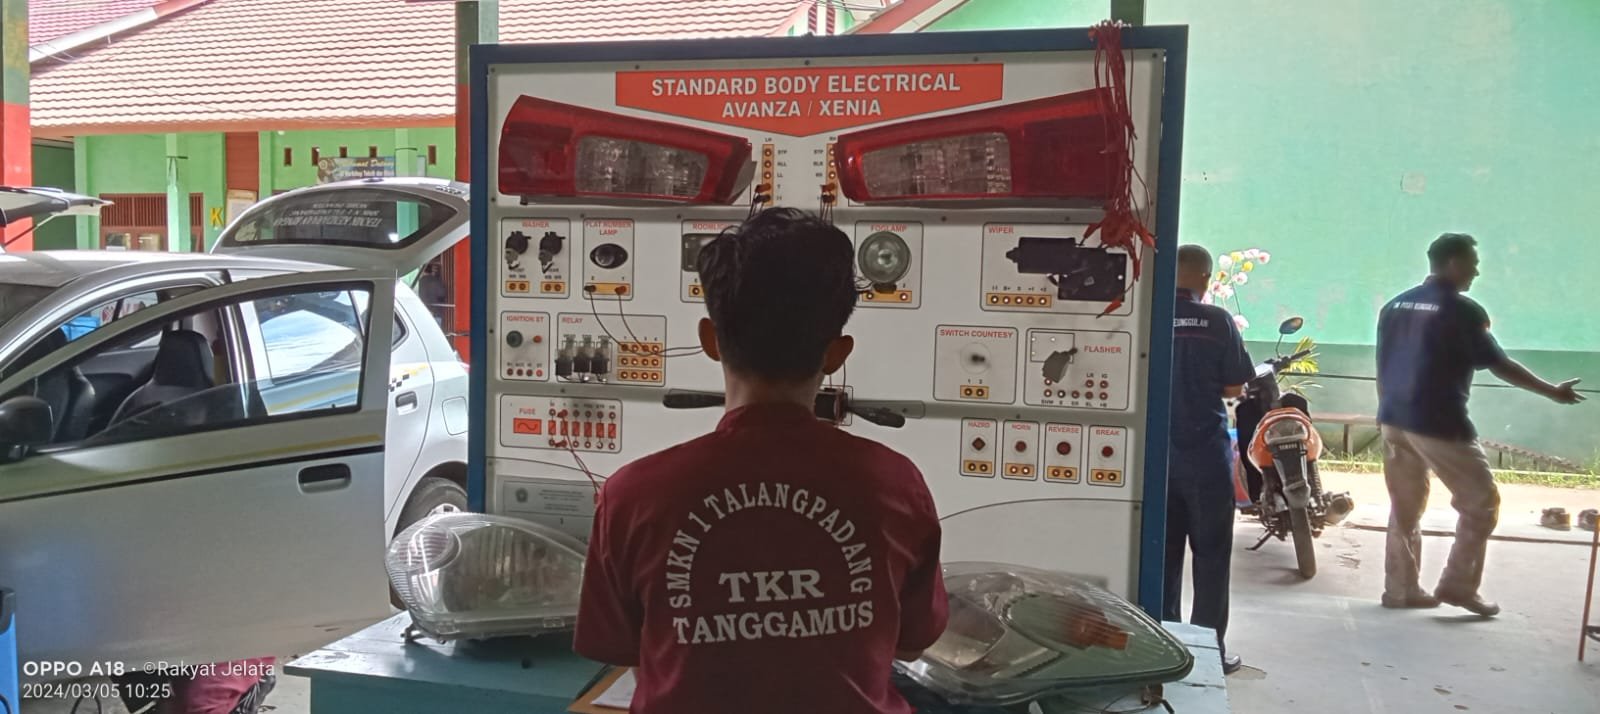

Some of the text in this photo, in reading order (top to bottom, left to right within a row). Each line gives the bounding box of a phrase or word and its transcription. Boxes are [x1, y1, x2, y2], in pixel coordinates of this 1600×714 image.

[652, 73, 961, 96] STANDARD BODY ELECTRICAL
[722, 101, 801, 118] AVANZA
[820, 99, 882, 116] XENIA
[870, 224, 908, 232] FOGLAMP
[506, 315, 534, 323] IGNITION
[940, 329, 970, 338] SWITCH
[1084, 345, 1122, 354] FLASHER
[519, 407, 536, 415] FUSE
[1011, 423, 1031, 431] HORN
[1048, 426, 1080, 434] REVERSE
[666, 529, 700, 609] SMKN
[704, 482, 873, 594] TALANGPADANG
[718, 569, 824, 603] TKR
[673, 600, 874, 644] TANGGAMUS
